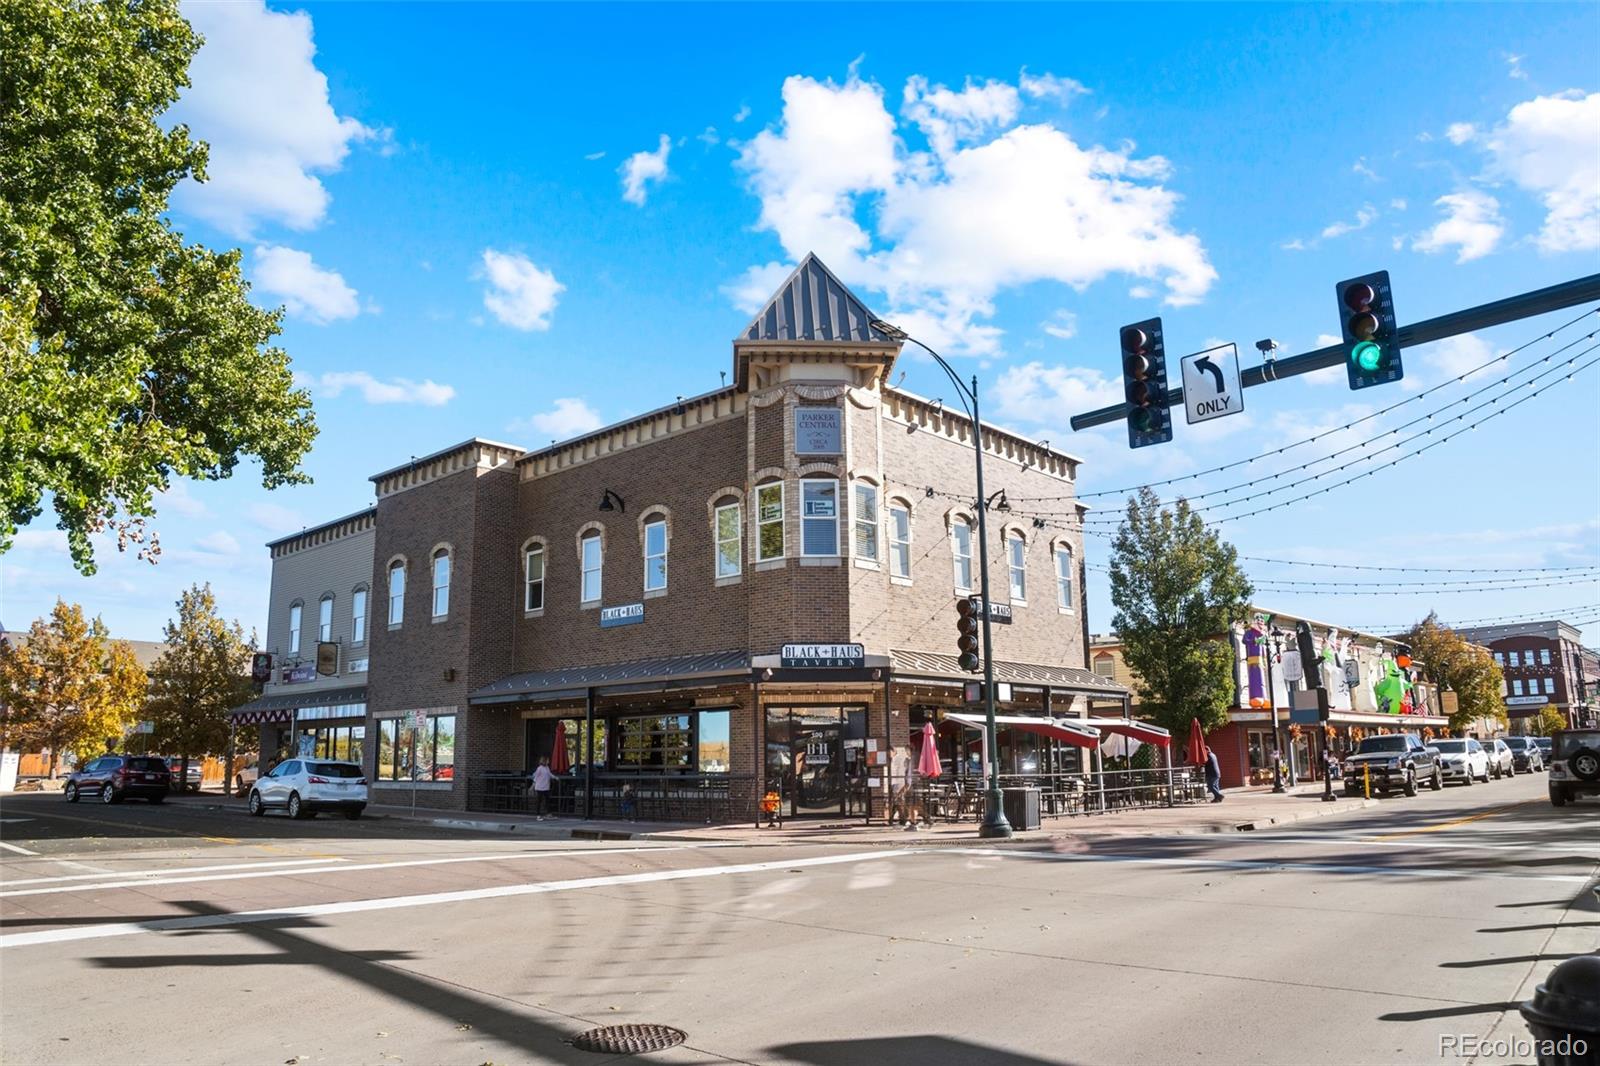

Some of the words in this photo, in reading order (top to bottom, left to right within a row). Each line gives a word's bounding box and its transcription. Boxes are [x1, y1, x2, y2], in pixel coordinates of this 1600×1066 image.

[1196, 395, 1231, 416] ONLY
[802, 413, 835, 421] PARKER
[799, 421, 838, 429] CENTRAL
